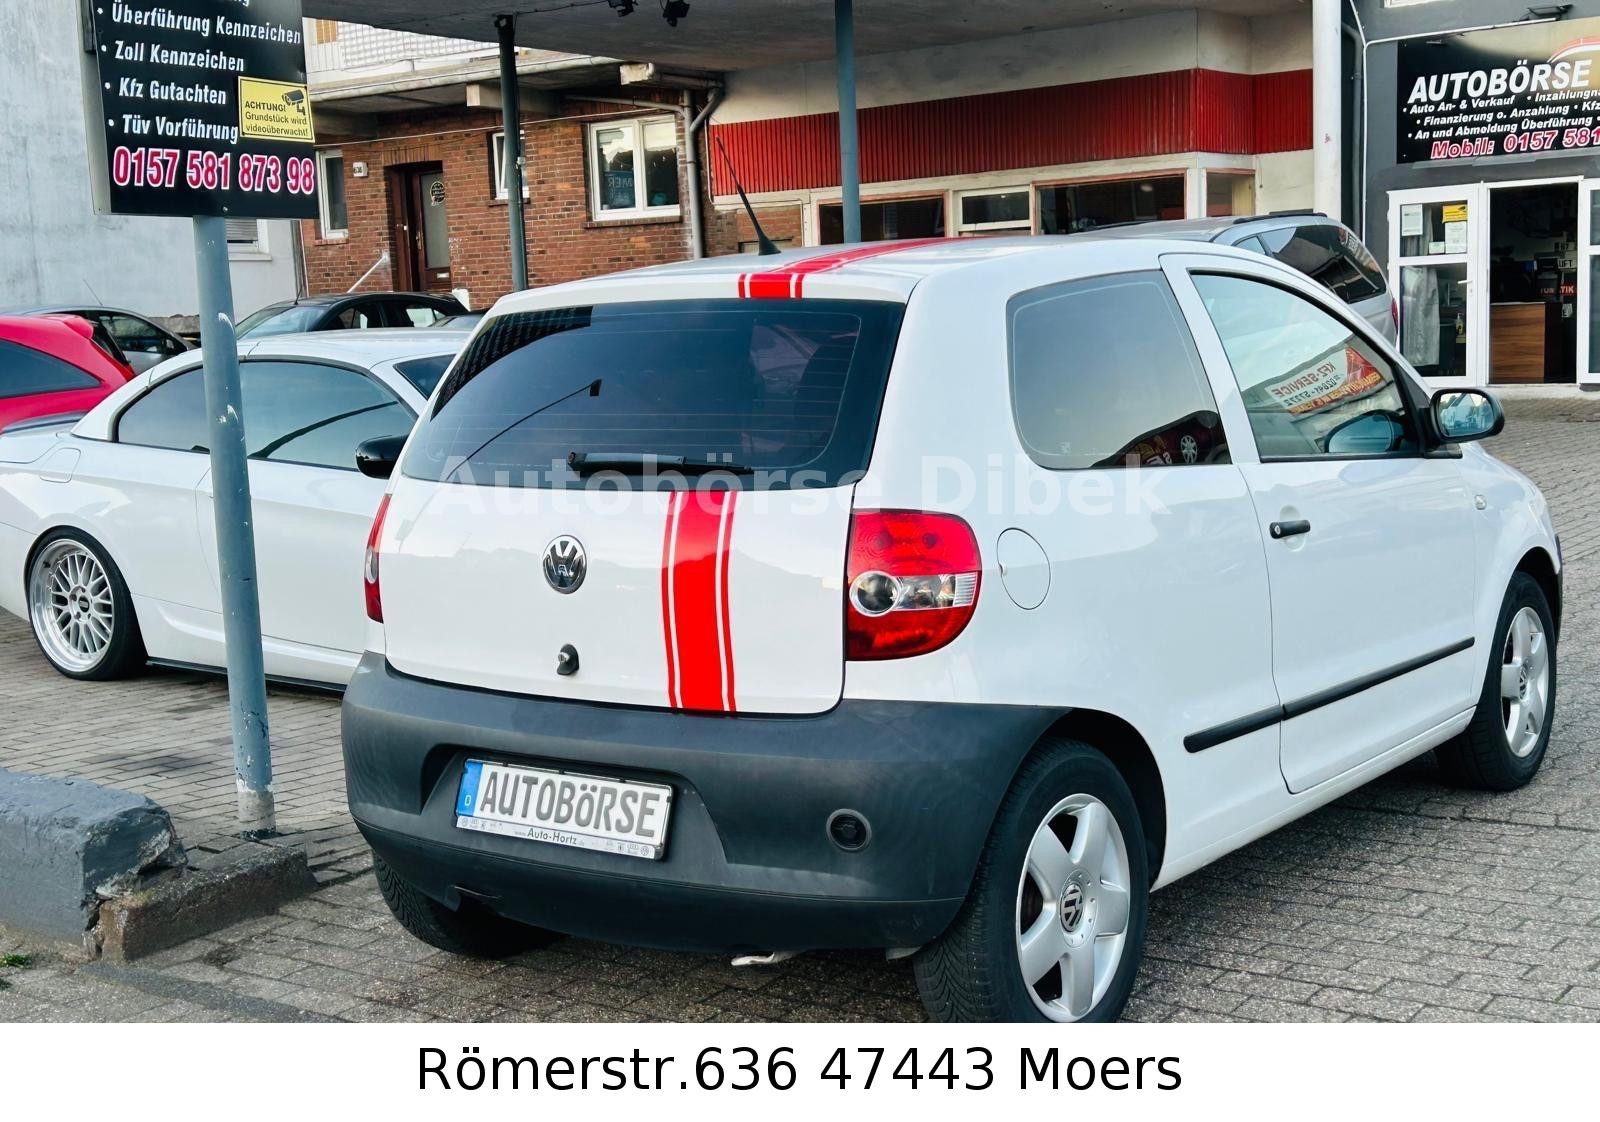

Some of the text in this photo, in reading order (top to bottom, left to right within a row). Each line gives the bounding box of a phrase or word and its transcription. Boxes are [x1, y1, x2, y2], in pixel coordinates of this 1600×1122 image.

[112, 0, 301, 44] Überführung Kennzeichen
[115, 40, 244, 72] Zoll Kennzeichen
[119, 77, 227, 105] Kfz Gutachten
[1407, 59, 1592, 104] AUTOBÖRSE
[244, 101, 286, 112] ACHTUNG!
[245, 112, 307, 125] Grundstück wird
[1409, 104, 1435, 114] Auto
[1437, 101, 1456, 112] An-
[1459, 100, 1467, 109] &
[1472, 95, 1515, 108] Verkauf
[1424, 111, 1494, 126] Finanzierung
[1497, 111, 1507, 119] o.
[1510, 105, 1570, 118] Anzahlung
[123, 114, 239, 145] Tüv Vorführung
[246, 123, 308, 136] videoüberwacht!
[1415, 116, 1593, 140] An und Abmeldung Überführung
[1431, 126, 1600, 159] Mobil: 0157 581
[113, 145, 315, 195] 0157 581 873 98
